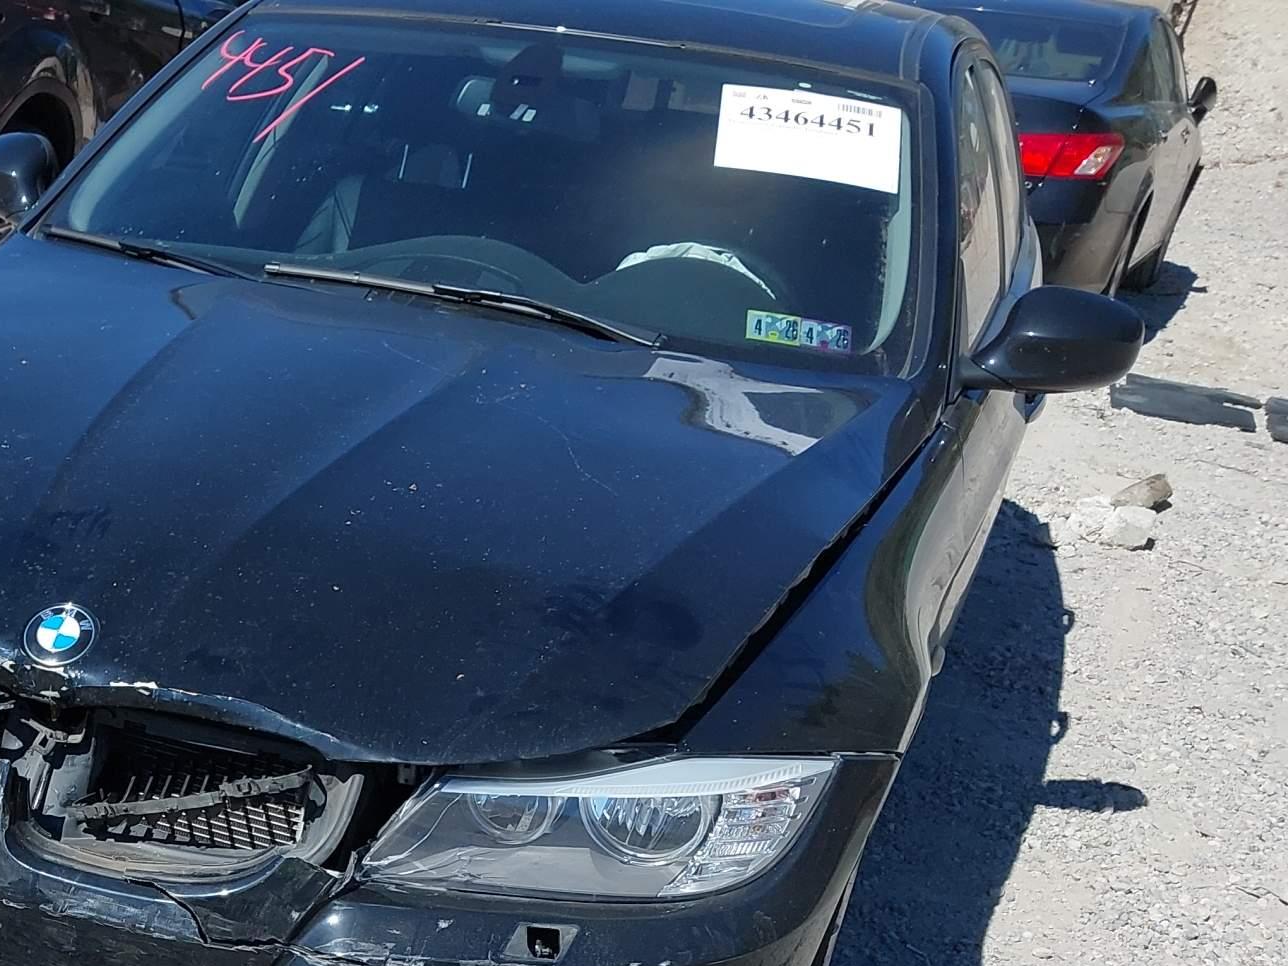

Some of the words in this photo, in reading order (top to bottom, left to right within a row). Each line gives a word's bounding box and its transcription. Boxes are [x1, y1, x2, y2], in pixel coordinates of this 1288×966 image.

[200, 29, 366, 144] 4451
[740, 105, 875, 137] 43464451
[754, 319, 763, 336] 4
[806, 327, 814, 344] 4
[40, 607, 93, 632] BMW
